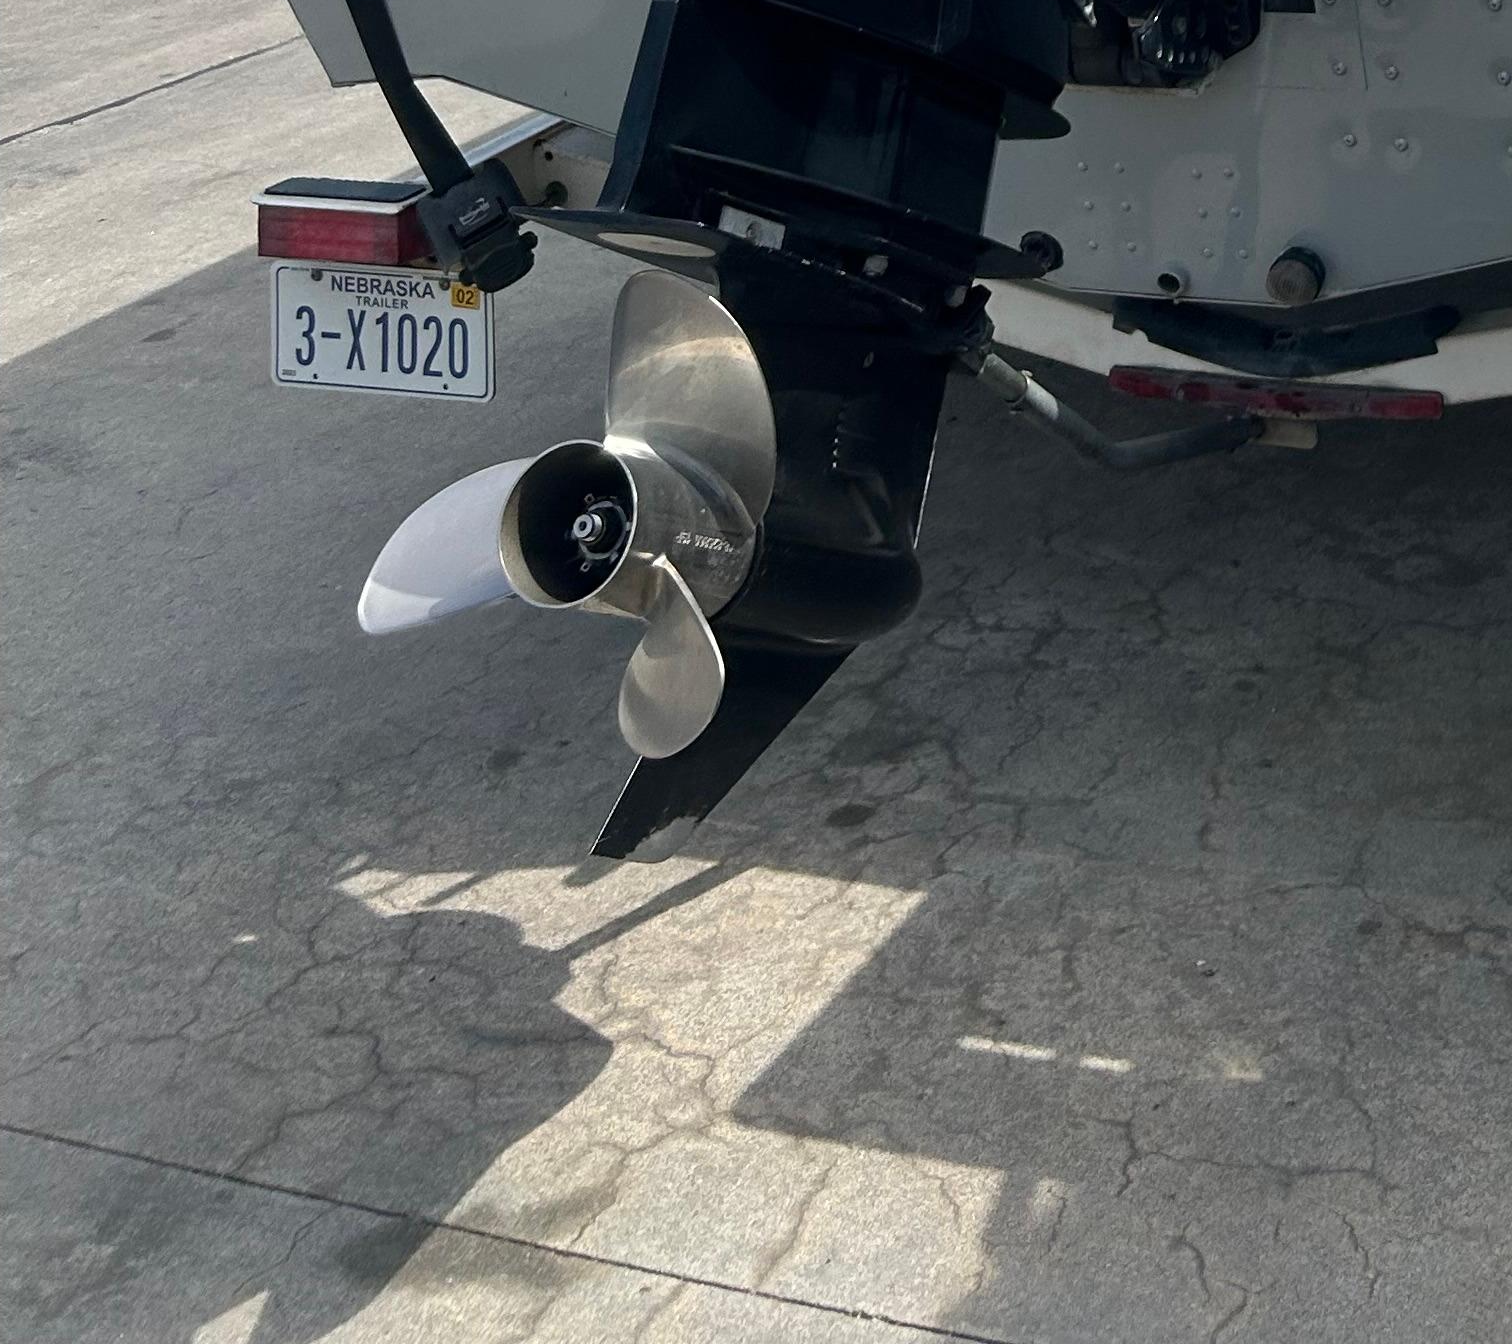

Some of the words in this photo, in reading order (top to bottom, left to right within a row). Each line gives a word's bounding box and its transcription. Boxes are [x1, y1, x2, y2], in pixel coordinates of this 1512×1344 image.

[330, 275, 436, 300] NEBRASKA
[455, 289, 475, 305] 02
[355, 295, 409, 310] TRAILER
[295, 305, 469, 379] 3-X1020
